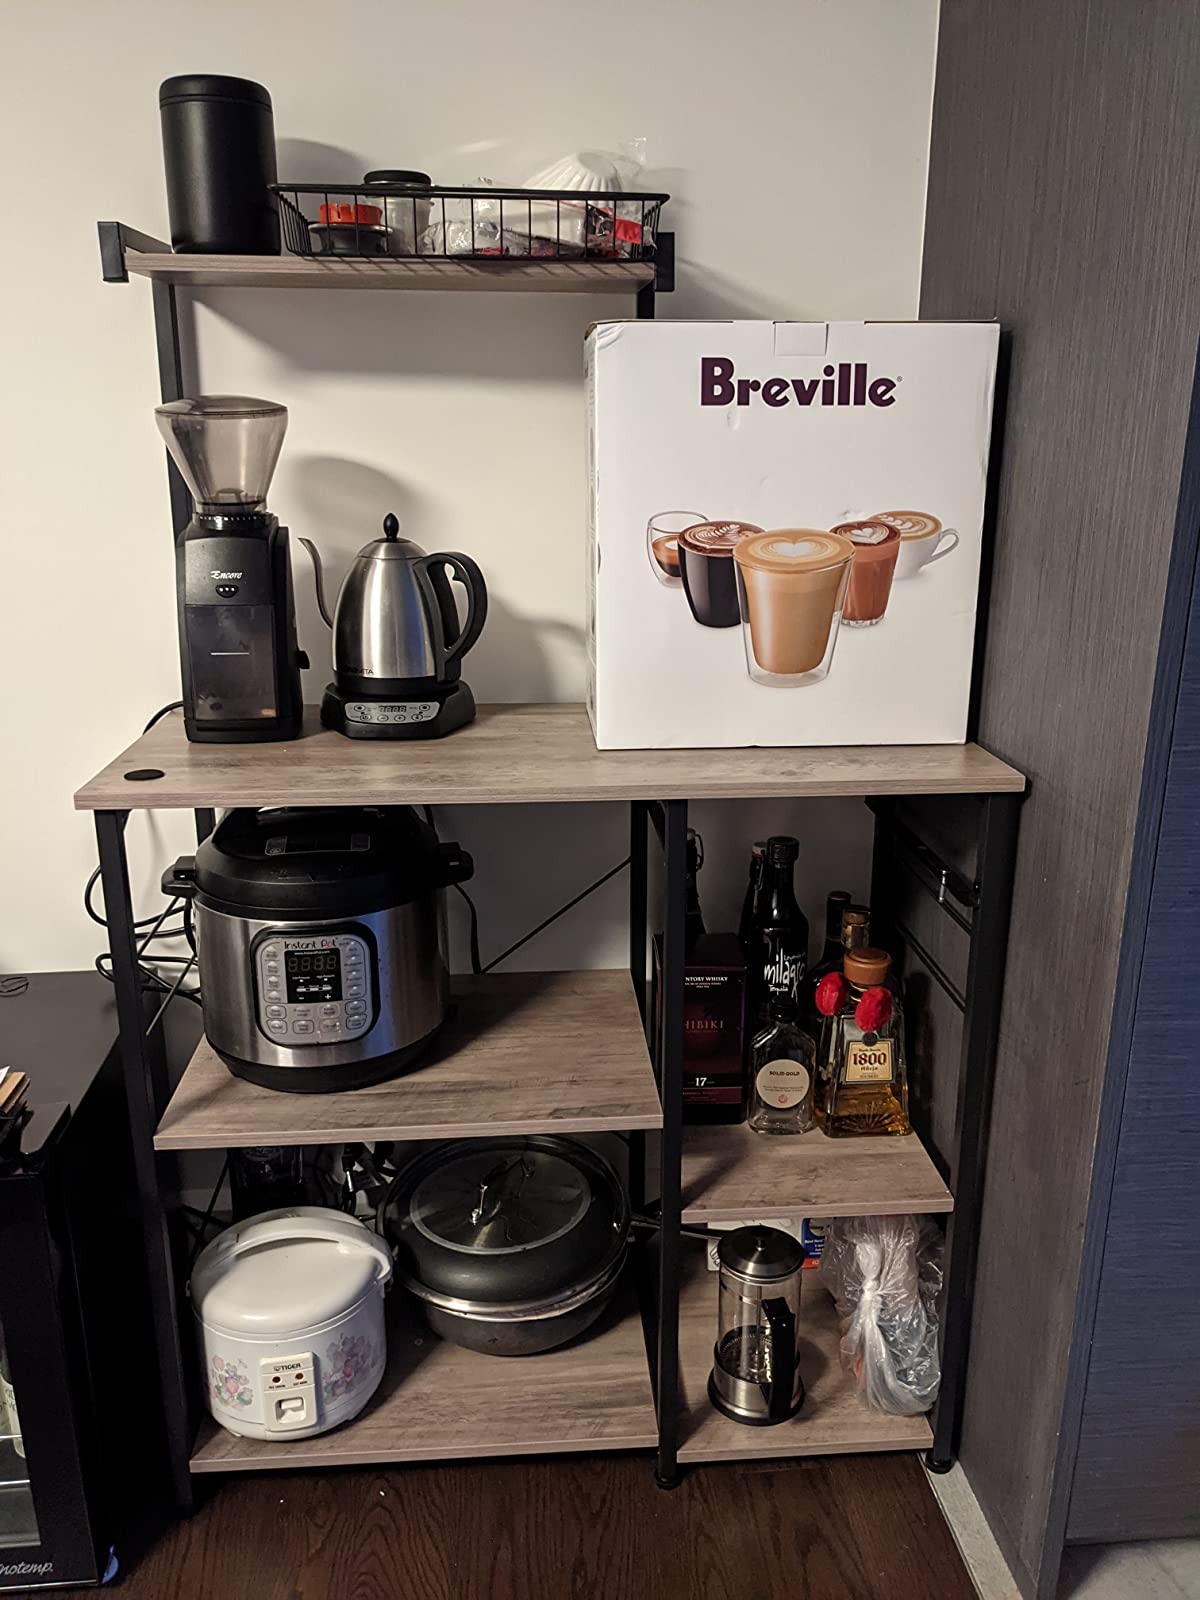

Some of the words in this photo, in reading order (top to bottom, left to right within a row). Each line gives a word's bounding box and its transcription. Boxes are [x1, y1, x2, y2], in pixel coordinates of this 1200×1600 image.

[701, 357, 897, 407] Breville
[210, 570, 243, 579] Encore
[284, 940, 317, 950] Instant
[321, 938, 338, 948] Pot
[763, 947, 805, 1004] milagro
[853, 1052, 887, 1066] 1800
[695, 1077, 708, 1087] 17
[281, 1363, 301, 1371] TIGER
